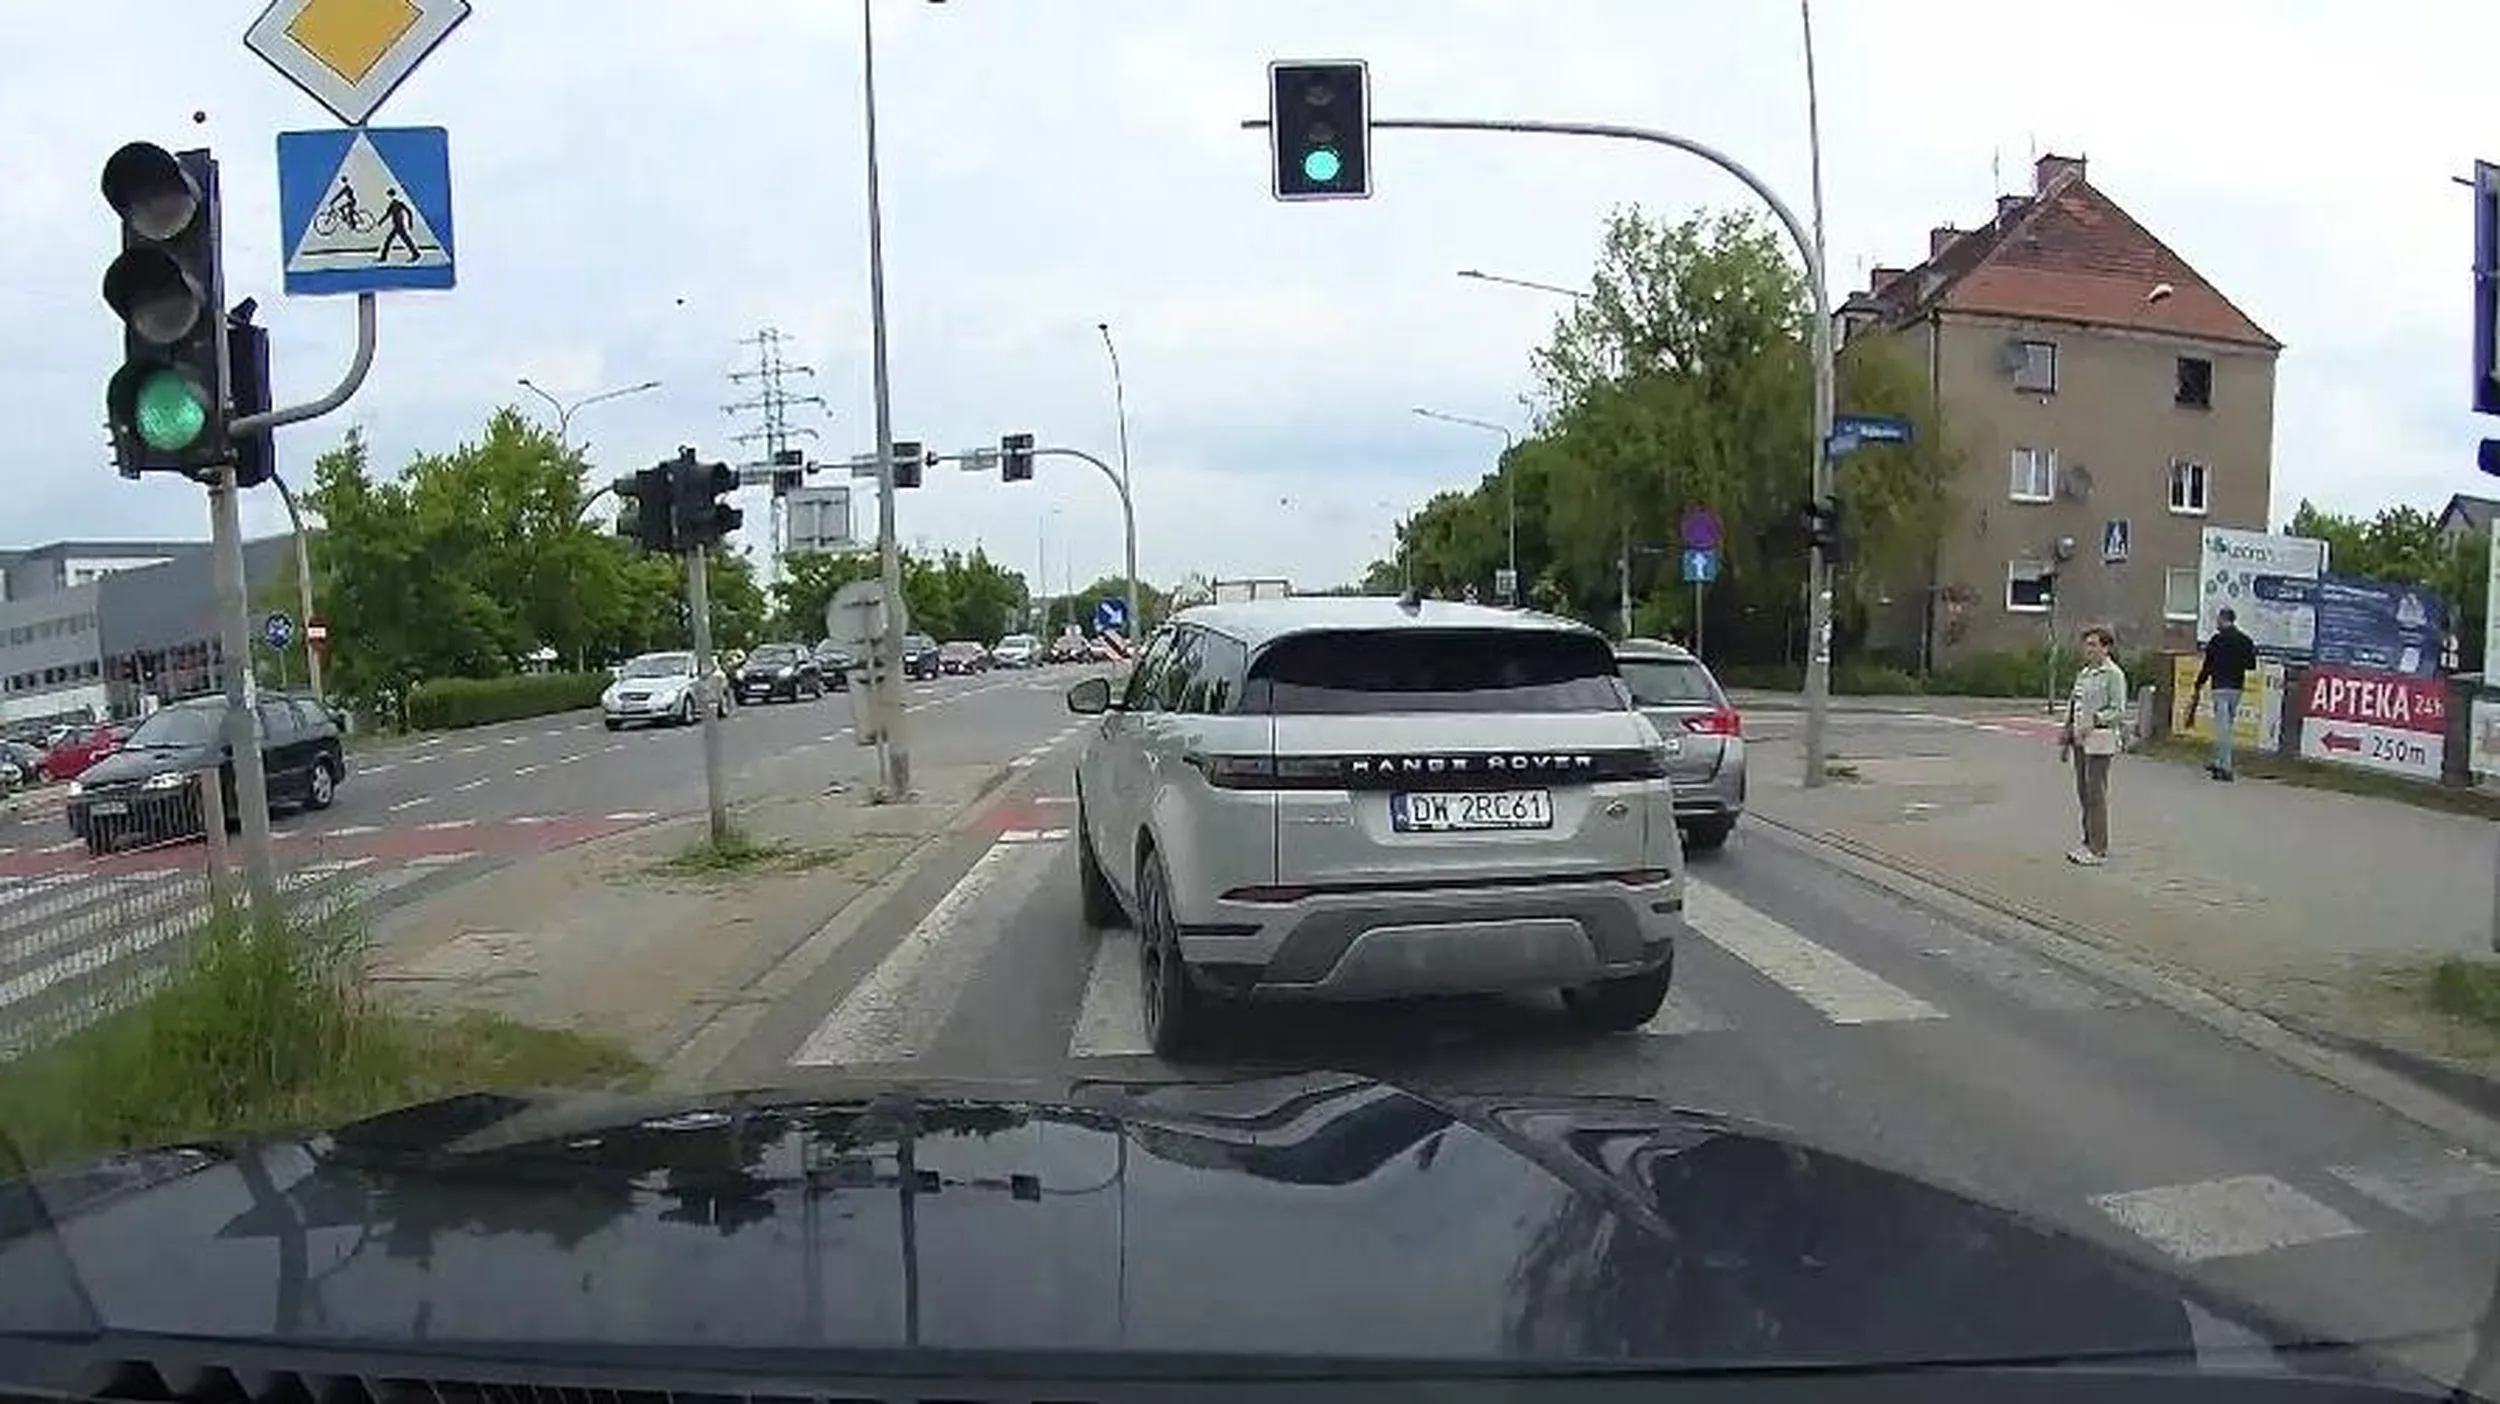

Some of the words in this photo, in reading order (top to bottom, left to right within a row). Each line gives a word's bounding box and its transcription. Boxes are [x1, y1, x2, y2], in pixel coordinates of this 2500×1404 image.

[2311, 677, 2410, 721] APTEKA
[2415, 694, 2444, 717] 24h
[1487, 755, 1593, 770] ROVER
[2372, 736, 2425, 765] 250m
[1413, 796, 1448, 822] DW
[1460, 793, 1544, 820] 2RC61
